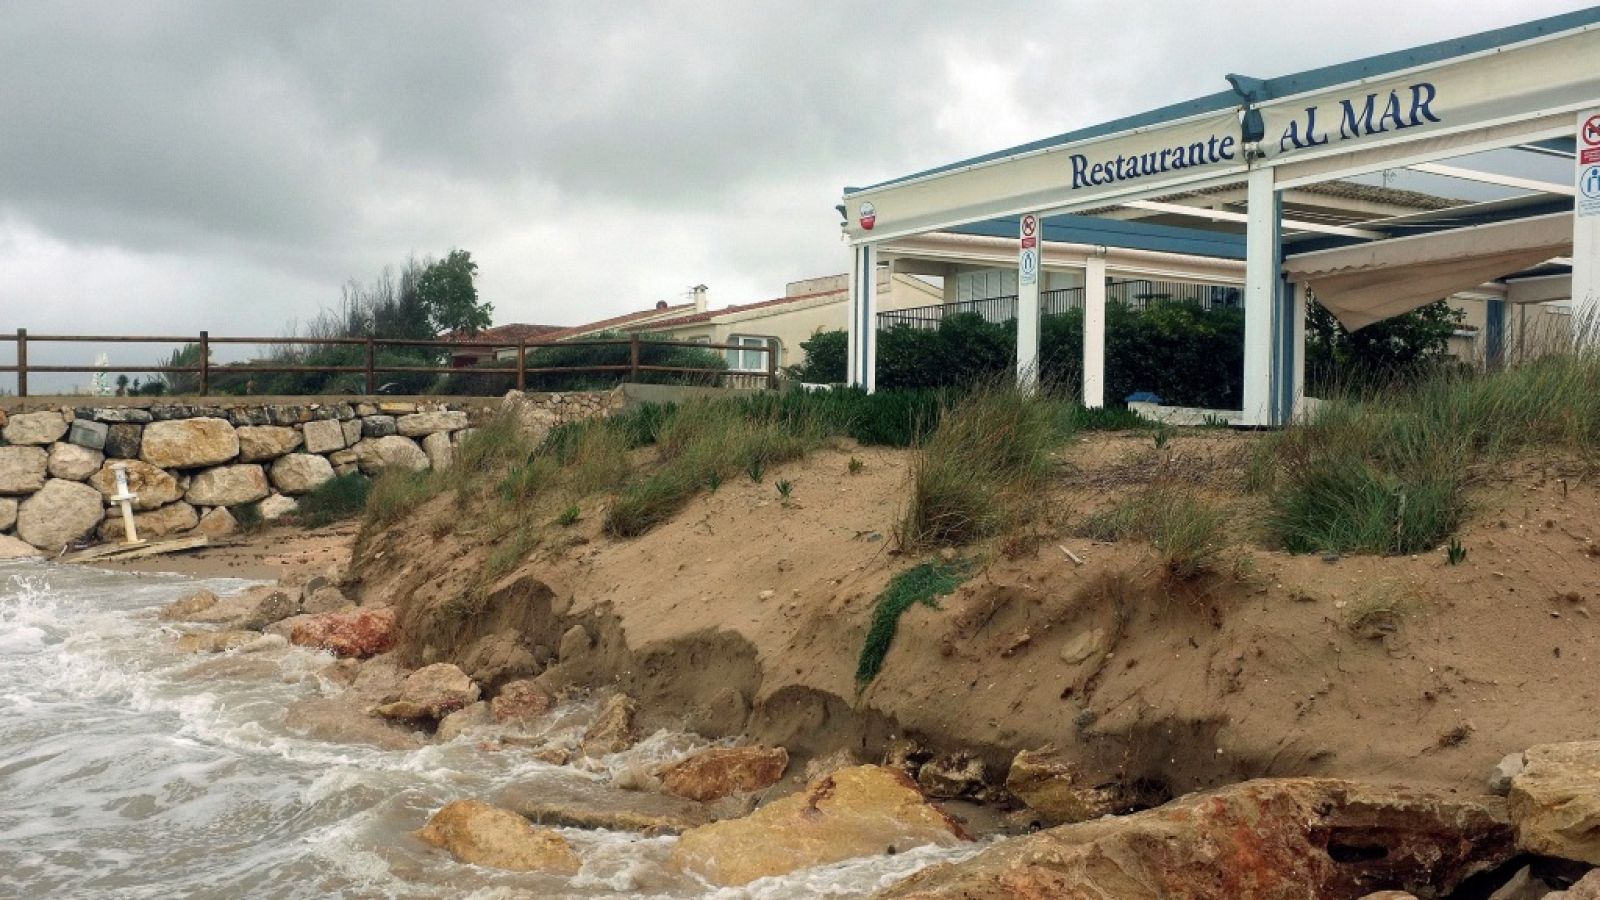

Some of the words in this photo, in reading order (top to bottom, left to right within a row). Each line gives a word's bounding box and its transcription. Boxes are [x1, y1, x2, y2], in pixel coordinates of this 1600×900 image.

[1069, 135, 1235, 190] Restaurante
[1279, 106, 1329, 153] AL
[1339, 82, 1441, 141] MAR
